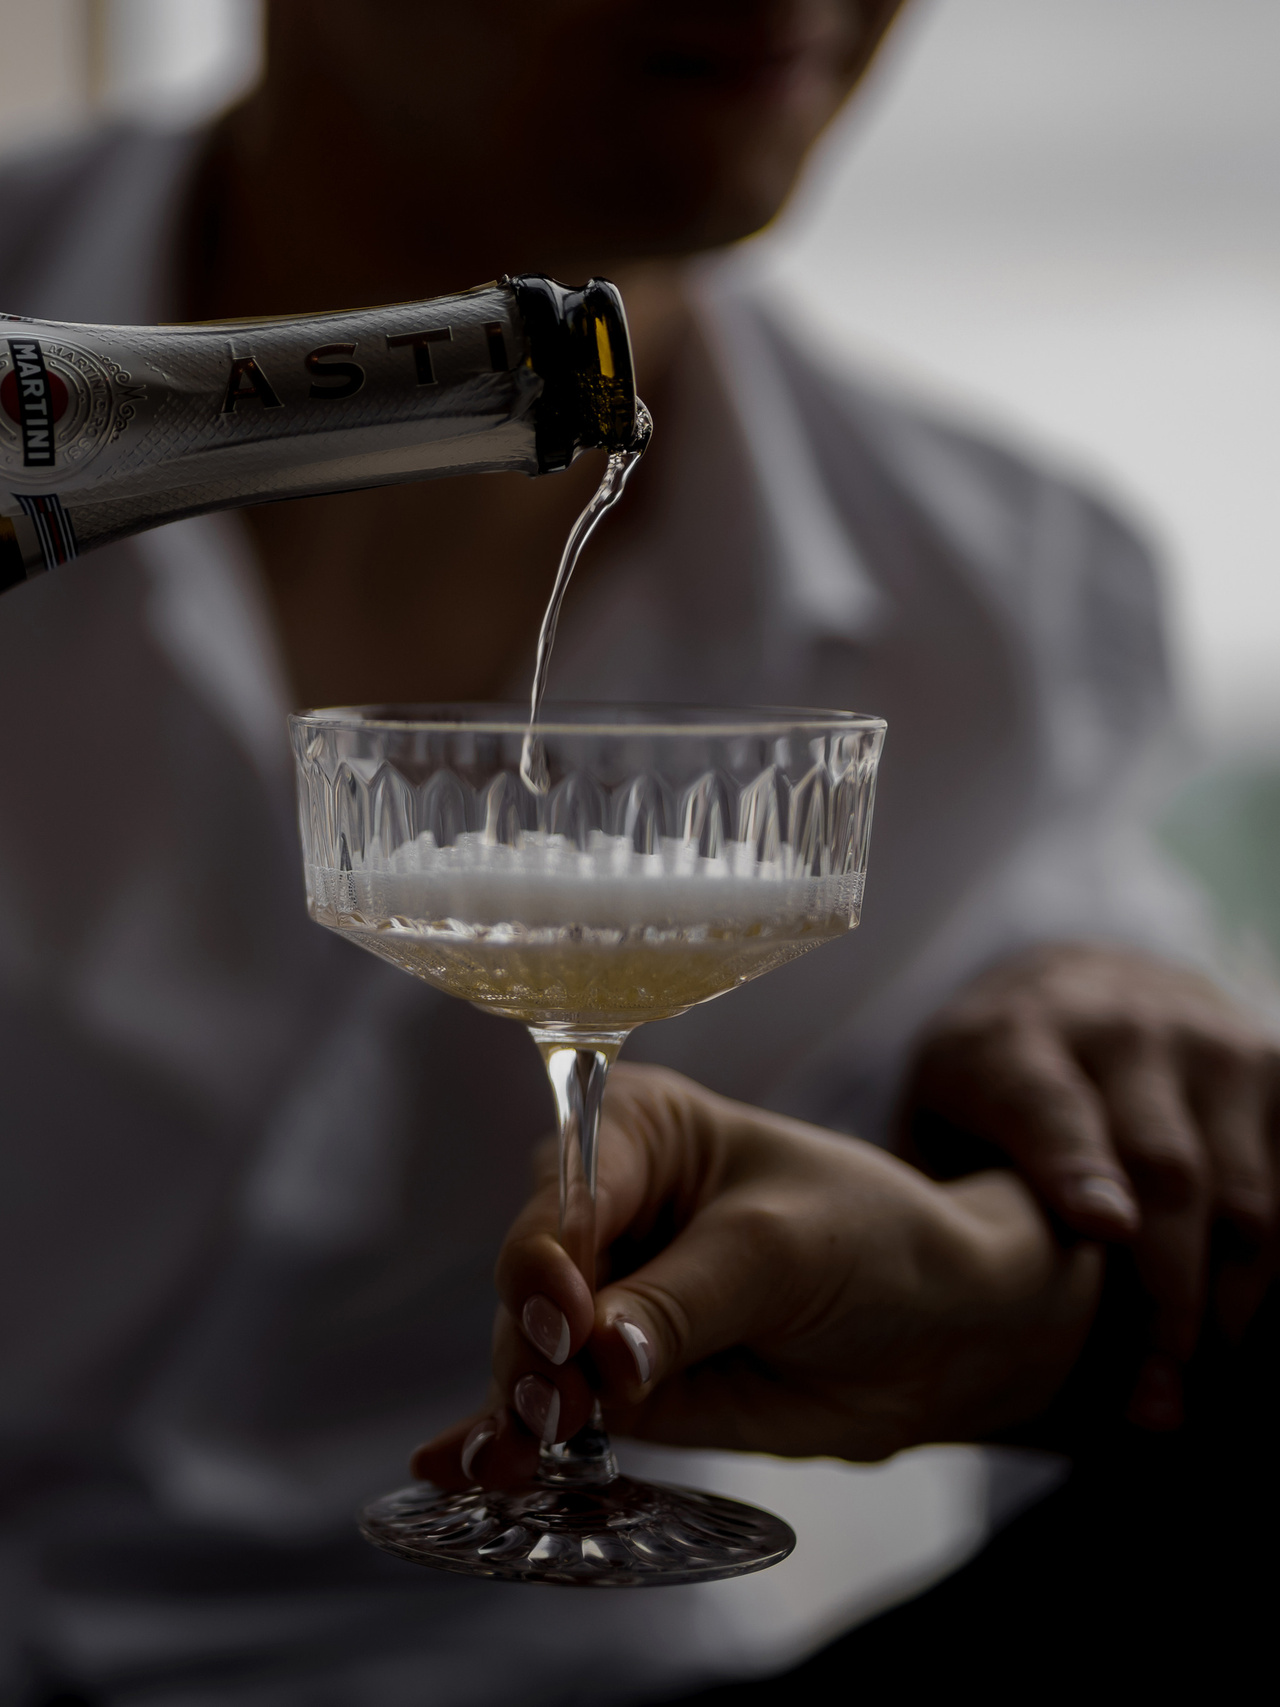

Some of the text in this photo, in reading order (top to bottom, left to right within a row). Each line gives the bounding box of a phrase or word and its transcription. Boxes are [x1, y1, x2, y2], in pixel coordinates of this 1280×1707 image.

[13, 343, 51, 460] MARTINI
[48, 344, 107, 394] MARTINI
[220, 321, 511, 414] ASTI
